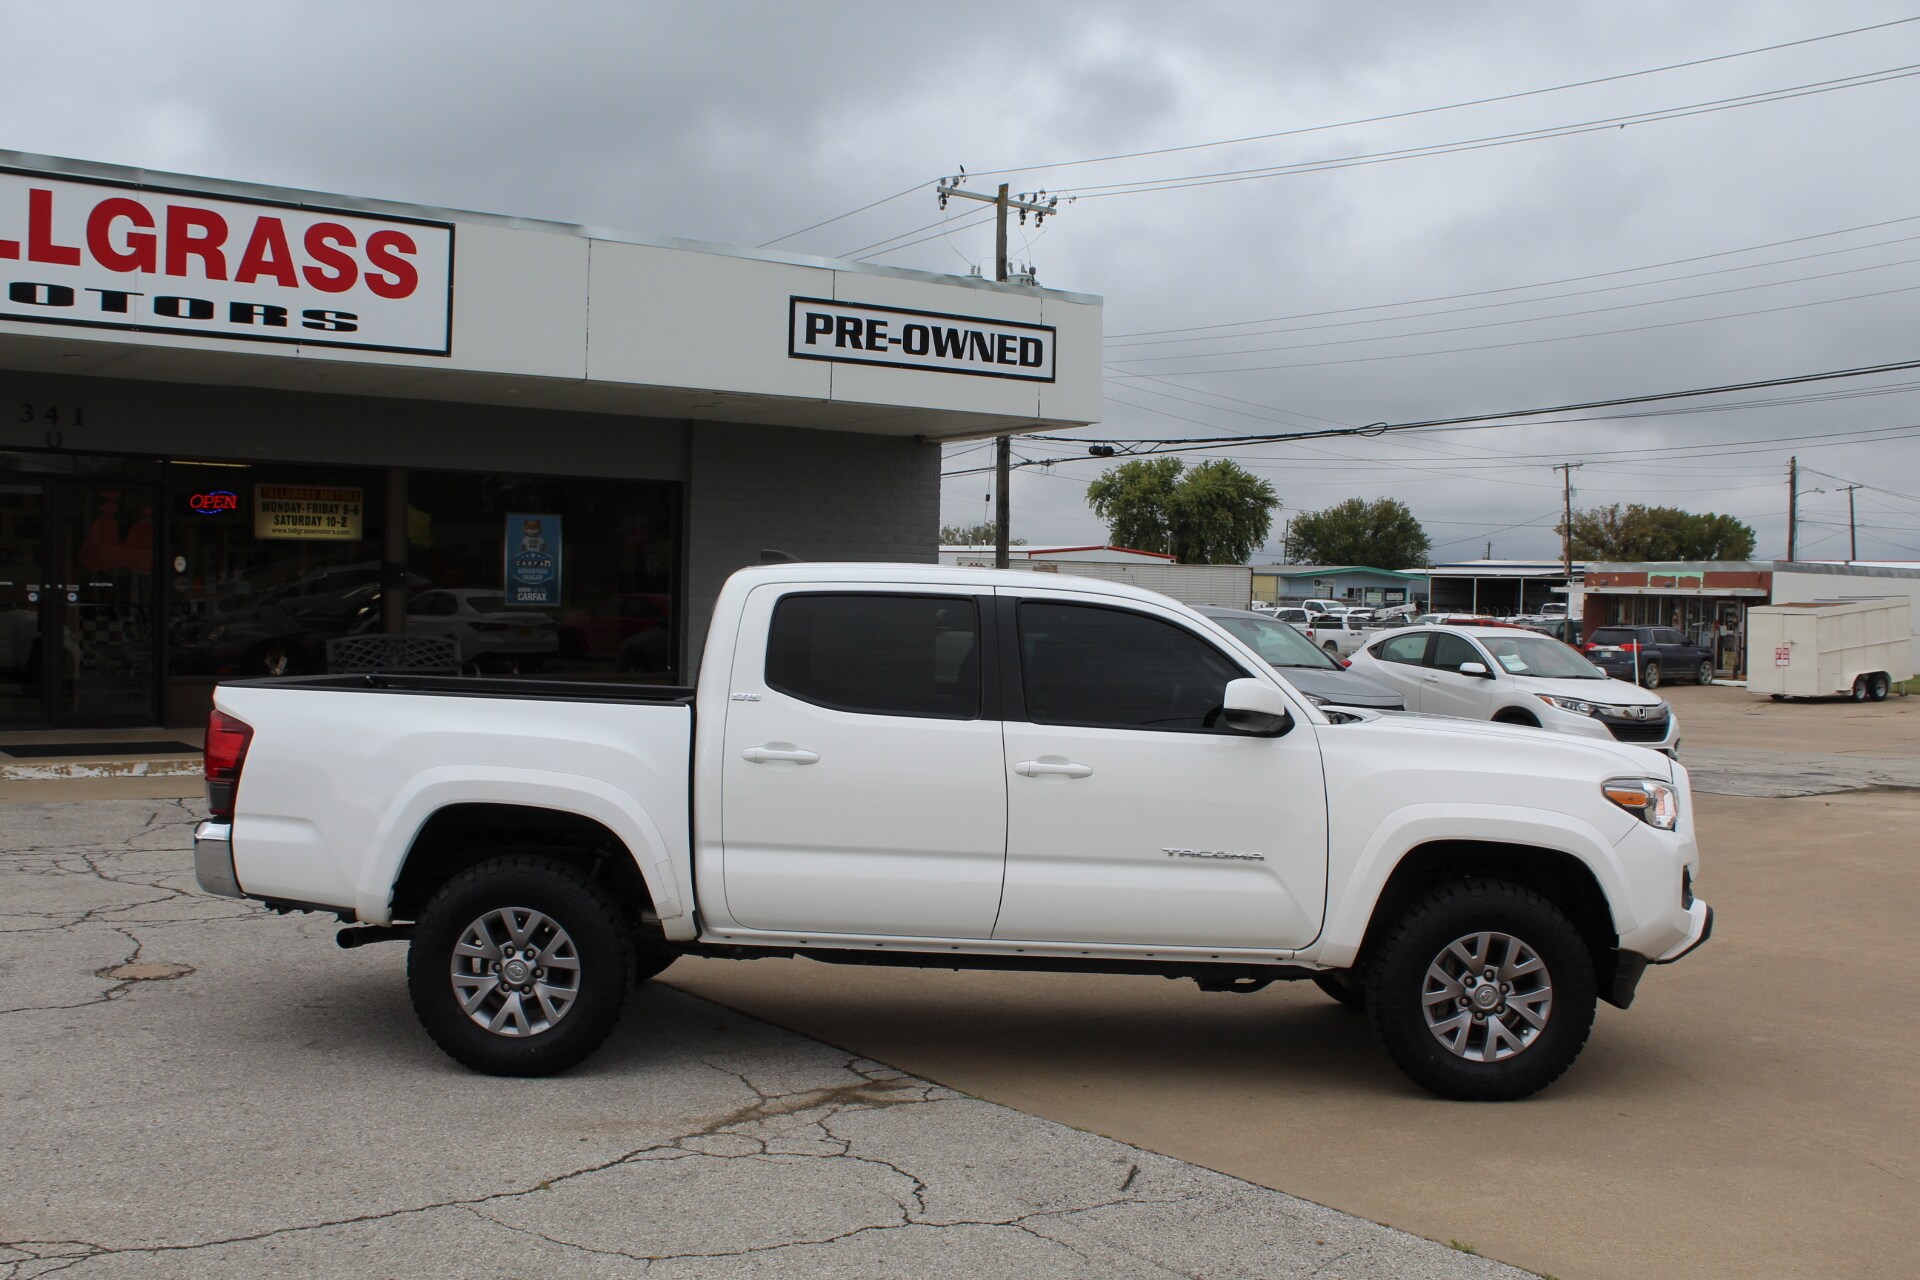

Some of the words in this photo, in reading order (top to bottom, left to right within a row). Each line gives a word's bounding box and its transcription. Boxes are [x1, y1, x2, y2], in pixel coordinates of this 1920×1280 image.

[805, 312, 1044, 369] PRE-OWNED
[17, 403, 84, 427] 341
[188, 493, 238, 510] OPEN
[263, 487, 318, 500] TALLGRASS
[319, 490, 360, 502] MOTORS
[262, 501, 340, 514] MONDAY-FRIDAY
[342, 504, 360, 516] 9-6
[274, 514, 322, 527] SATURDAY
[325, 516, 348, 528] 10-2
[517, 592, 547, 601] CARFAX
